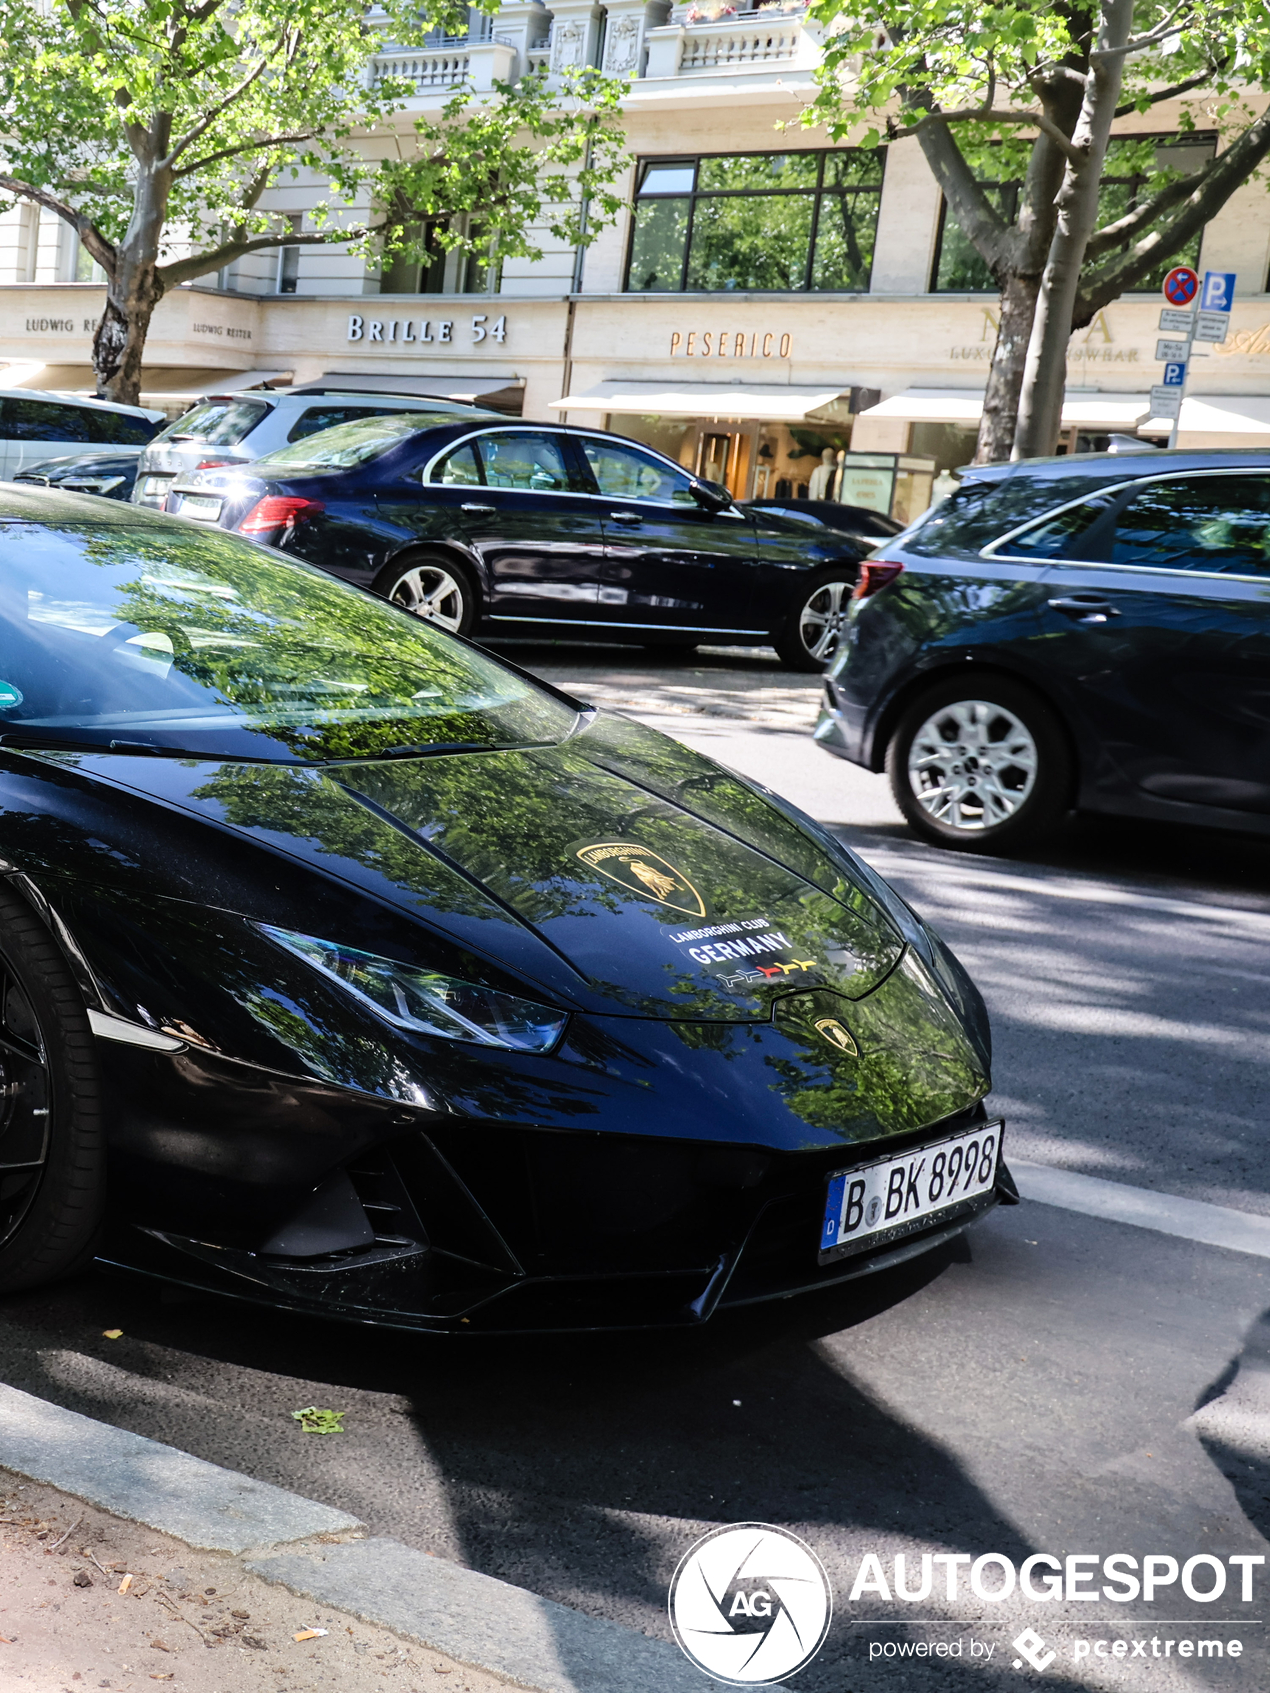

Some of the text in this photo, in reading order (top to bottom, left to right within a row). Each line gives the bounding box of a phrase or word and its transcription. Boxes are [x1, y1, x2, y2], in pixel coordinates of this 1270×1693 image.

[1205, 276, 1226, 306] P
[26, 319, 74, 332] LUDWIG
[193, 323, 252, 340] LUDWIG REITER
[471, 315, 507, 344] 54
[670, 332, 793, 358] PESERICO
[1166, 365, 1180, 383] P
[584, 846, 651, 864] LAMBORGHINI
[669, 918, 770, 943] LAMBORGHINI CLUB
[688, 932, 792, 964] GERMANY
[843, 1179, 866, 1234] B
[884, 1157, 926, 1220] BK
[928, 1135, 995, 1203] 8998
[826, 1219, 835, 1236] D
